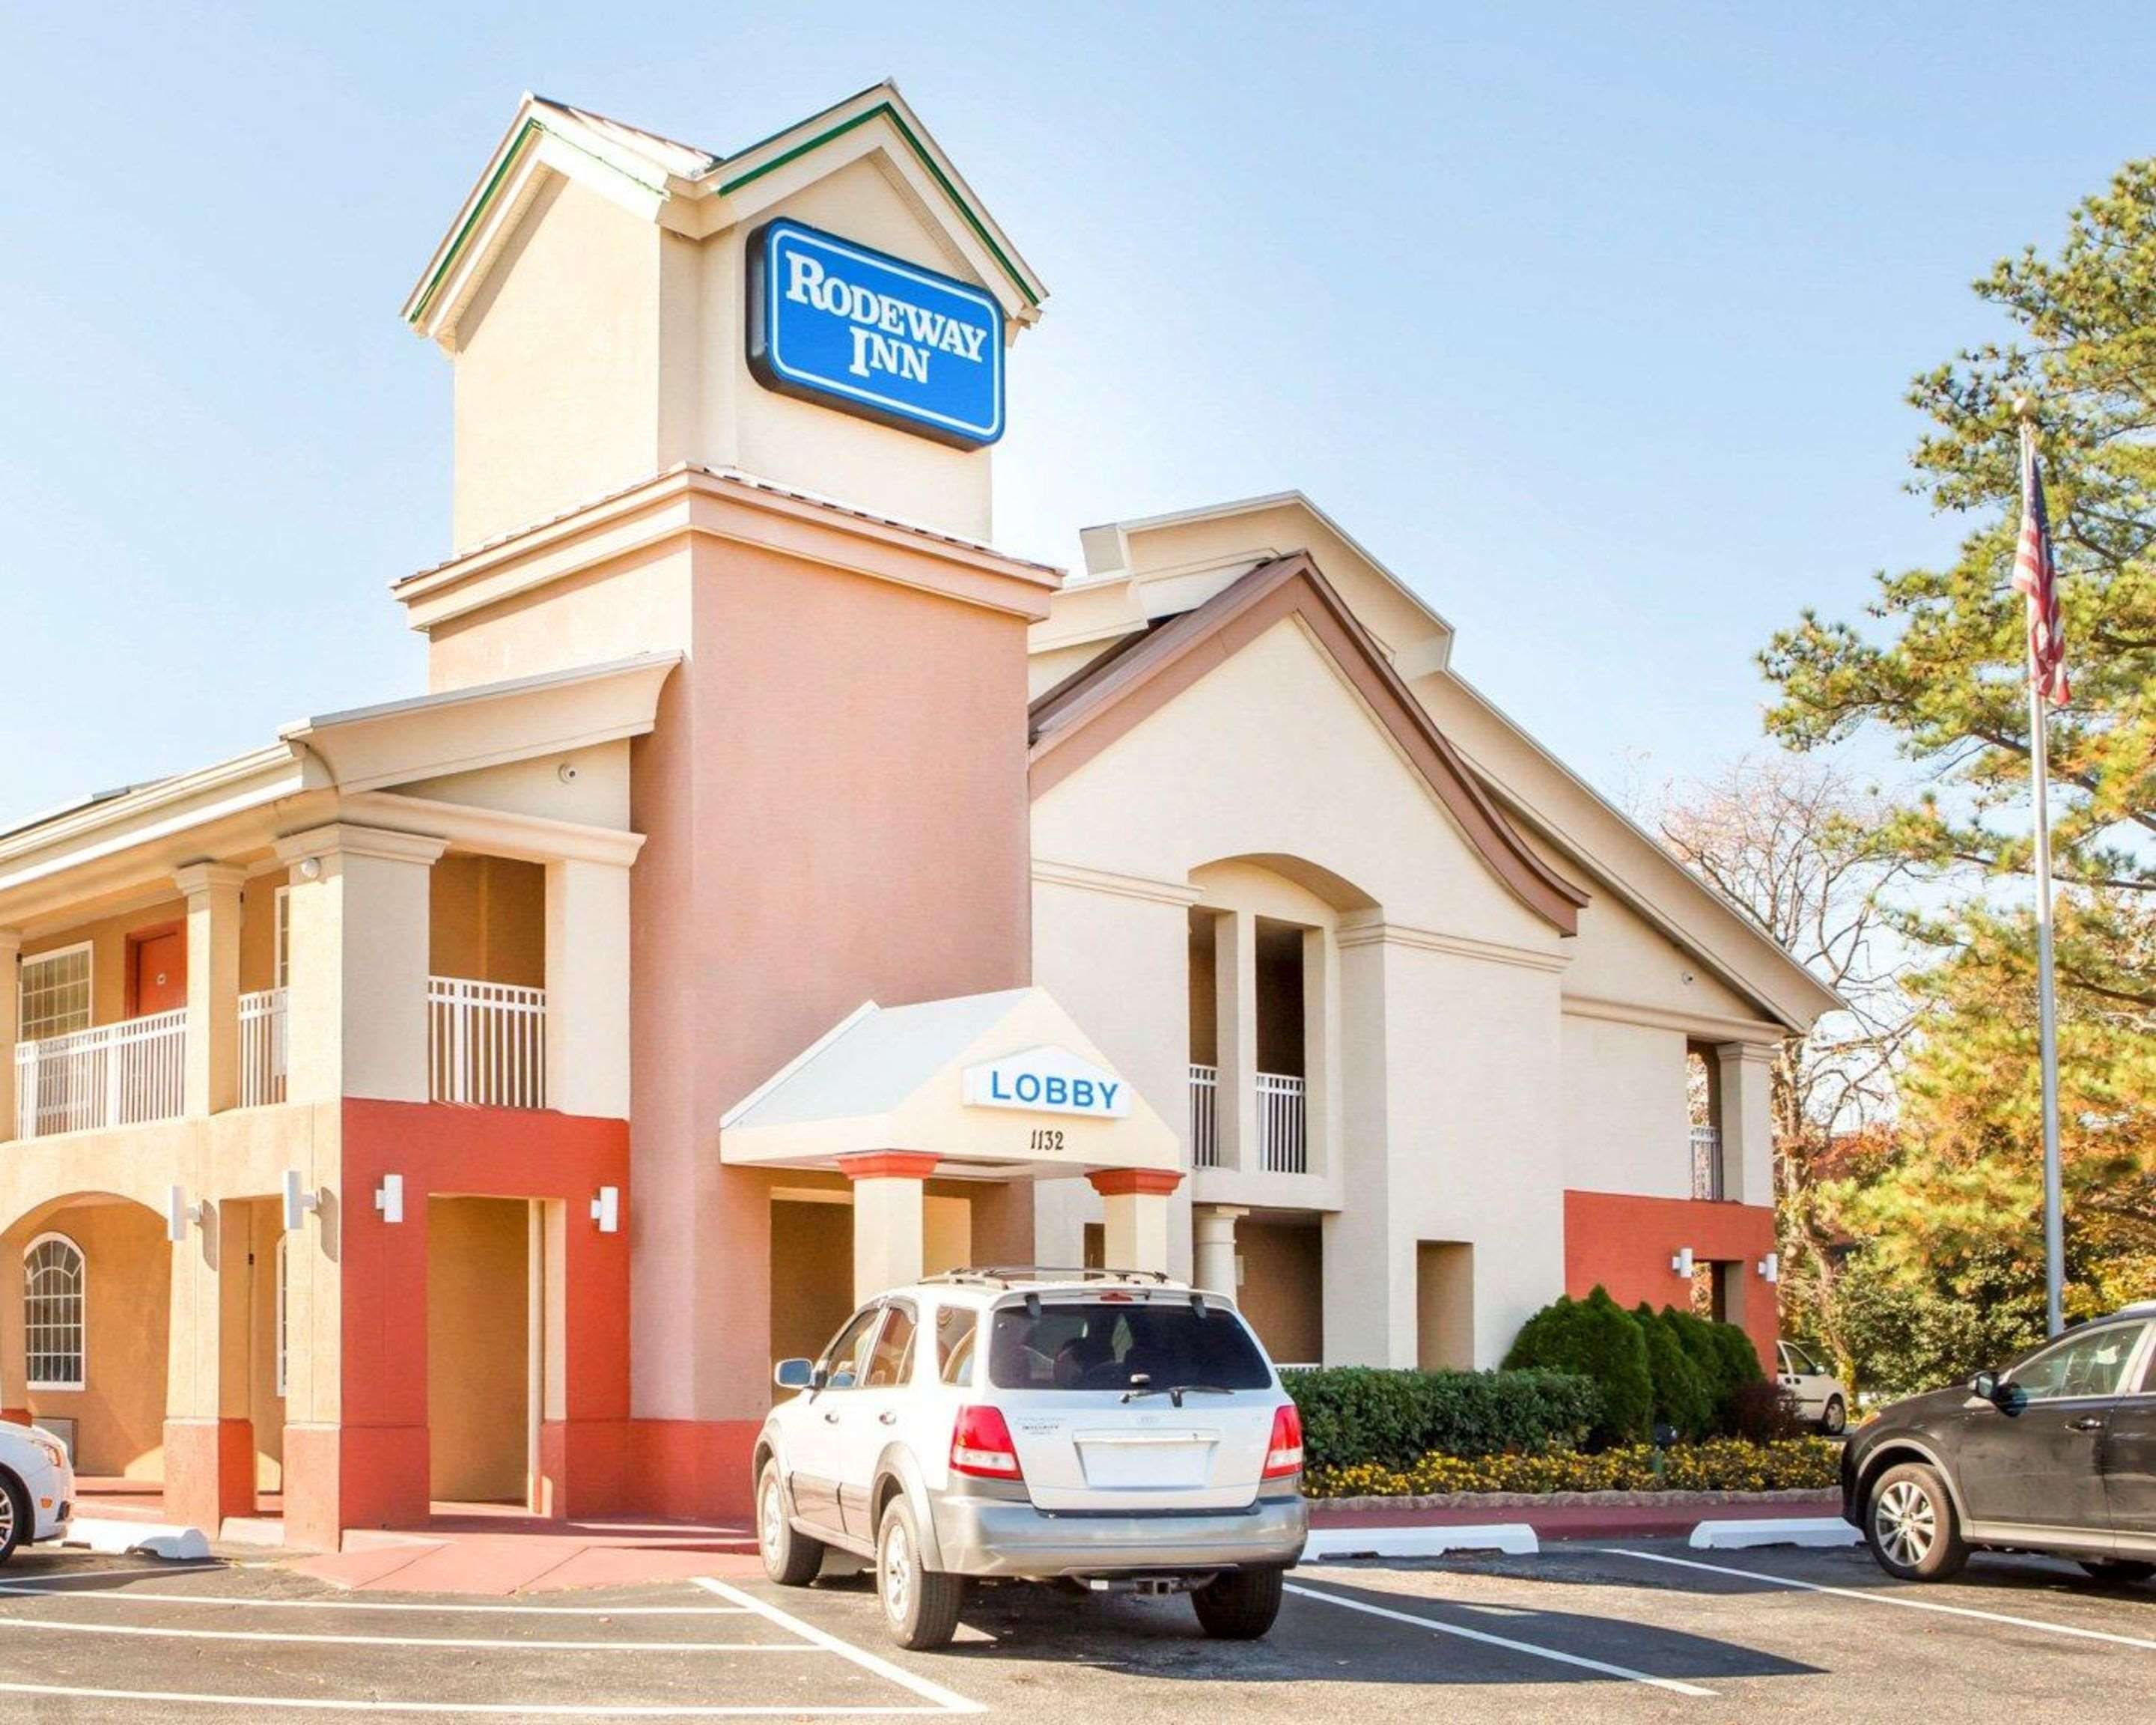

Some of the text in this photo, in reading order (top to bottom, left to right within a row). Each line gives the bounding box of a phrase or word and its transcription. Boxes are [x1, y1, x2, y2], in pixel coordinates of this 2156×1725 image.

[785, 250, 987, 362] RODEWAY
[849, 326, 931, 383] INN
[992, 1071, 1118, 1109] LOBBY
[1030, 1129, 1064, 1150] 1132
